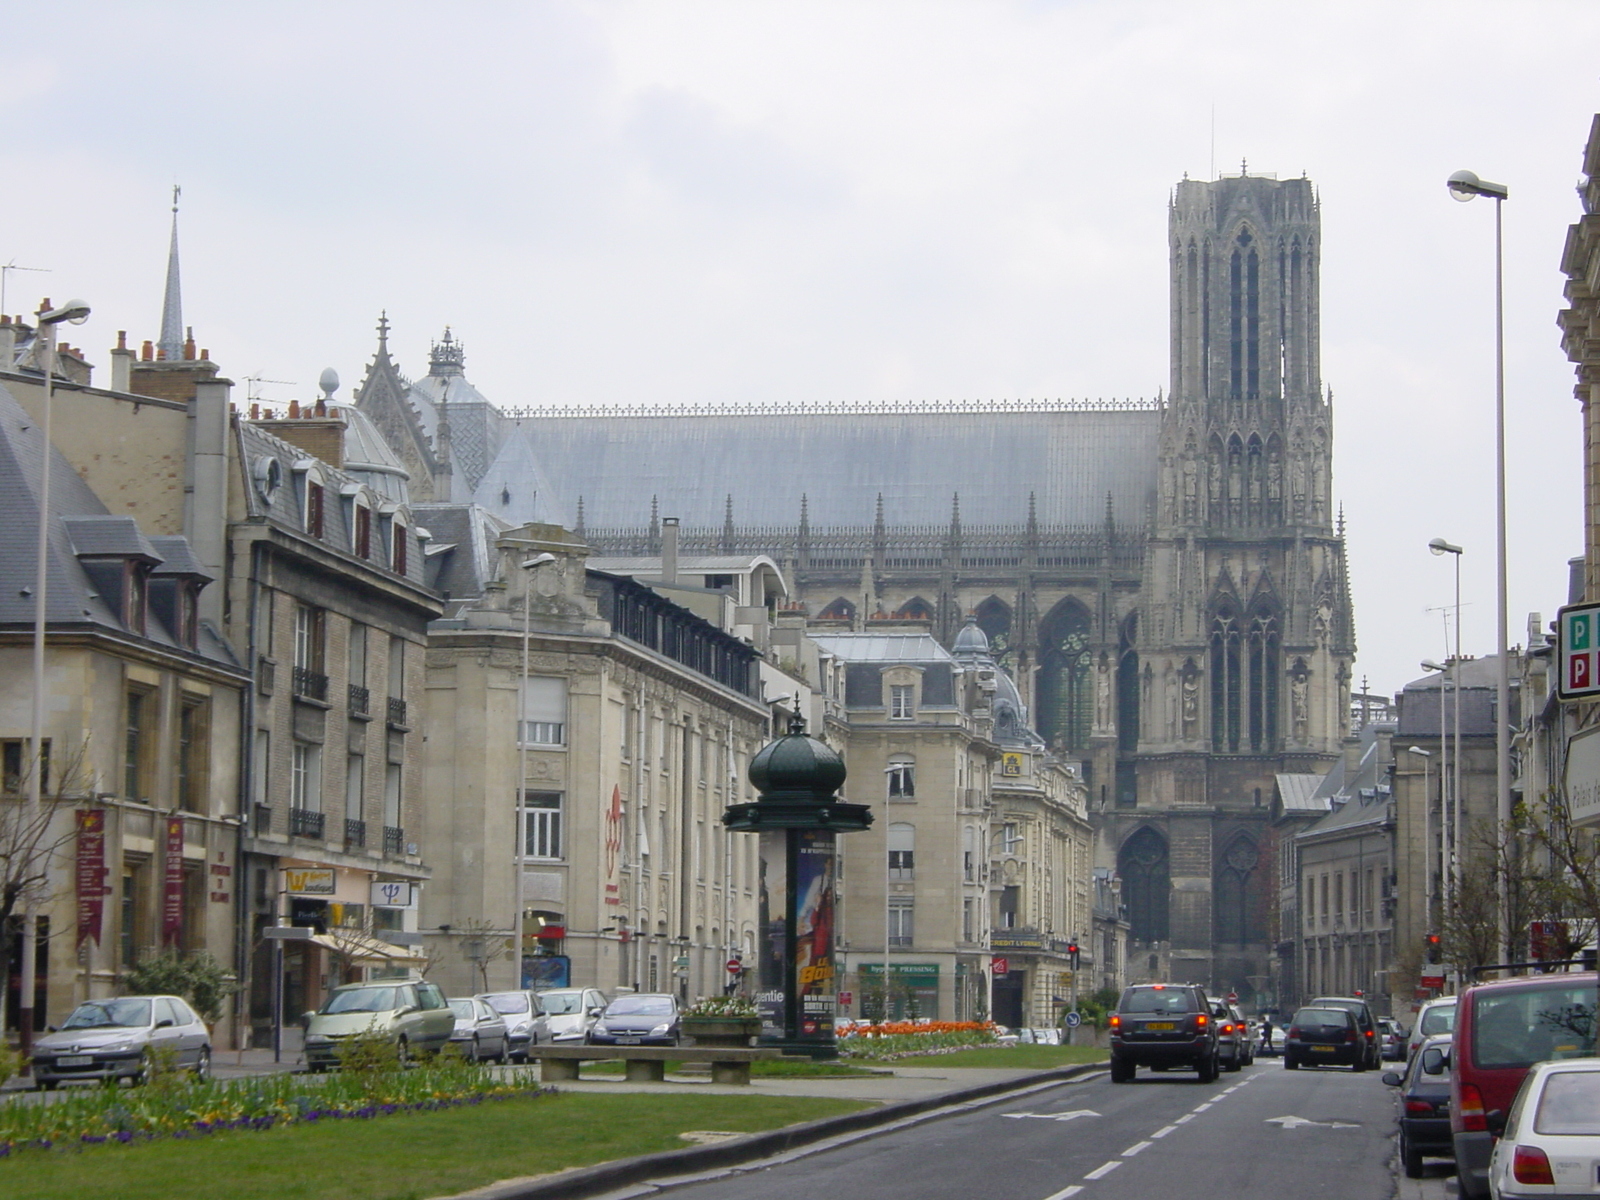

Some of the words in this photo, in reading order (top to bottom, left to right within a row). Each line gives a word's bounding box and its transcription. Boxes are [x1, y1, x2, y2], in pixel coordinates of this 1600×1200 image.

[1574, 620, 1585, 646] P
[1574, 658, 1585, 684] P
[1007, 765, 1018, 773] CL
[1573, 781, 1591, 809] Palais
